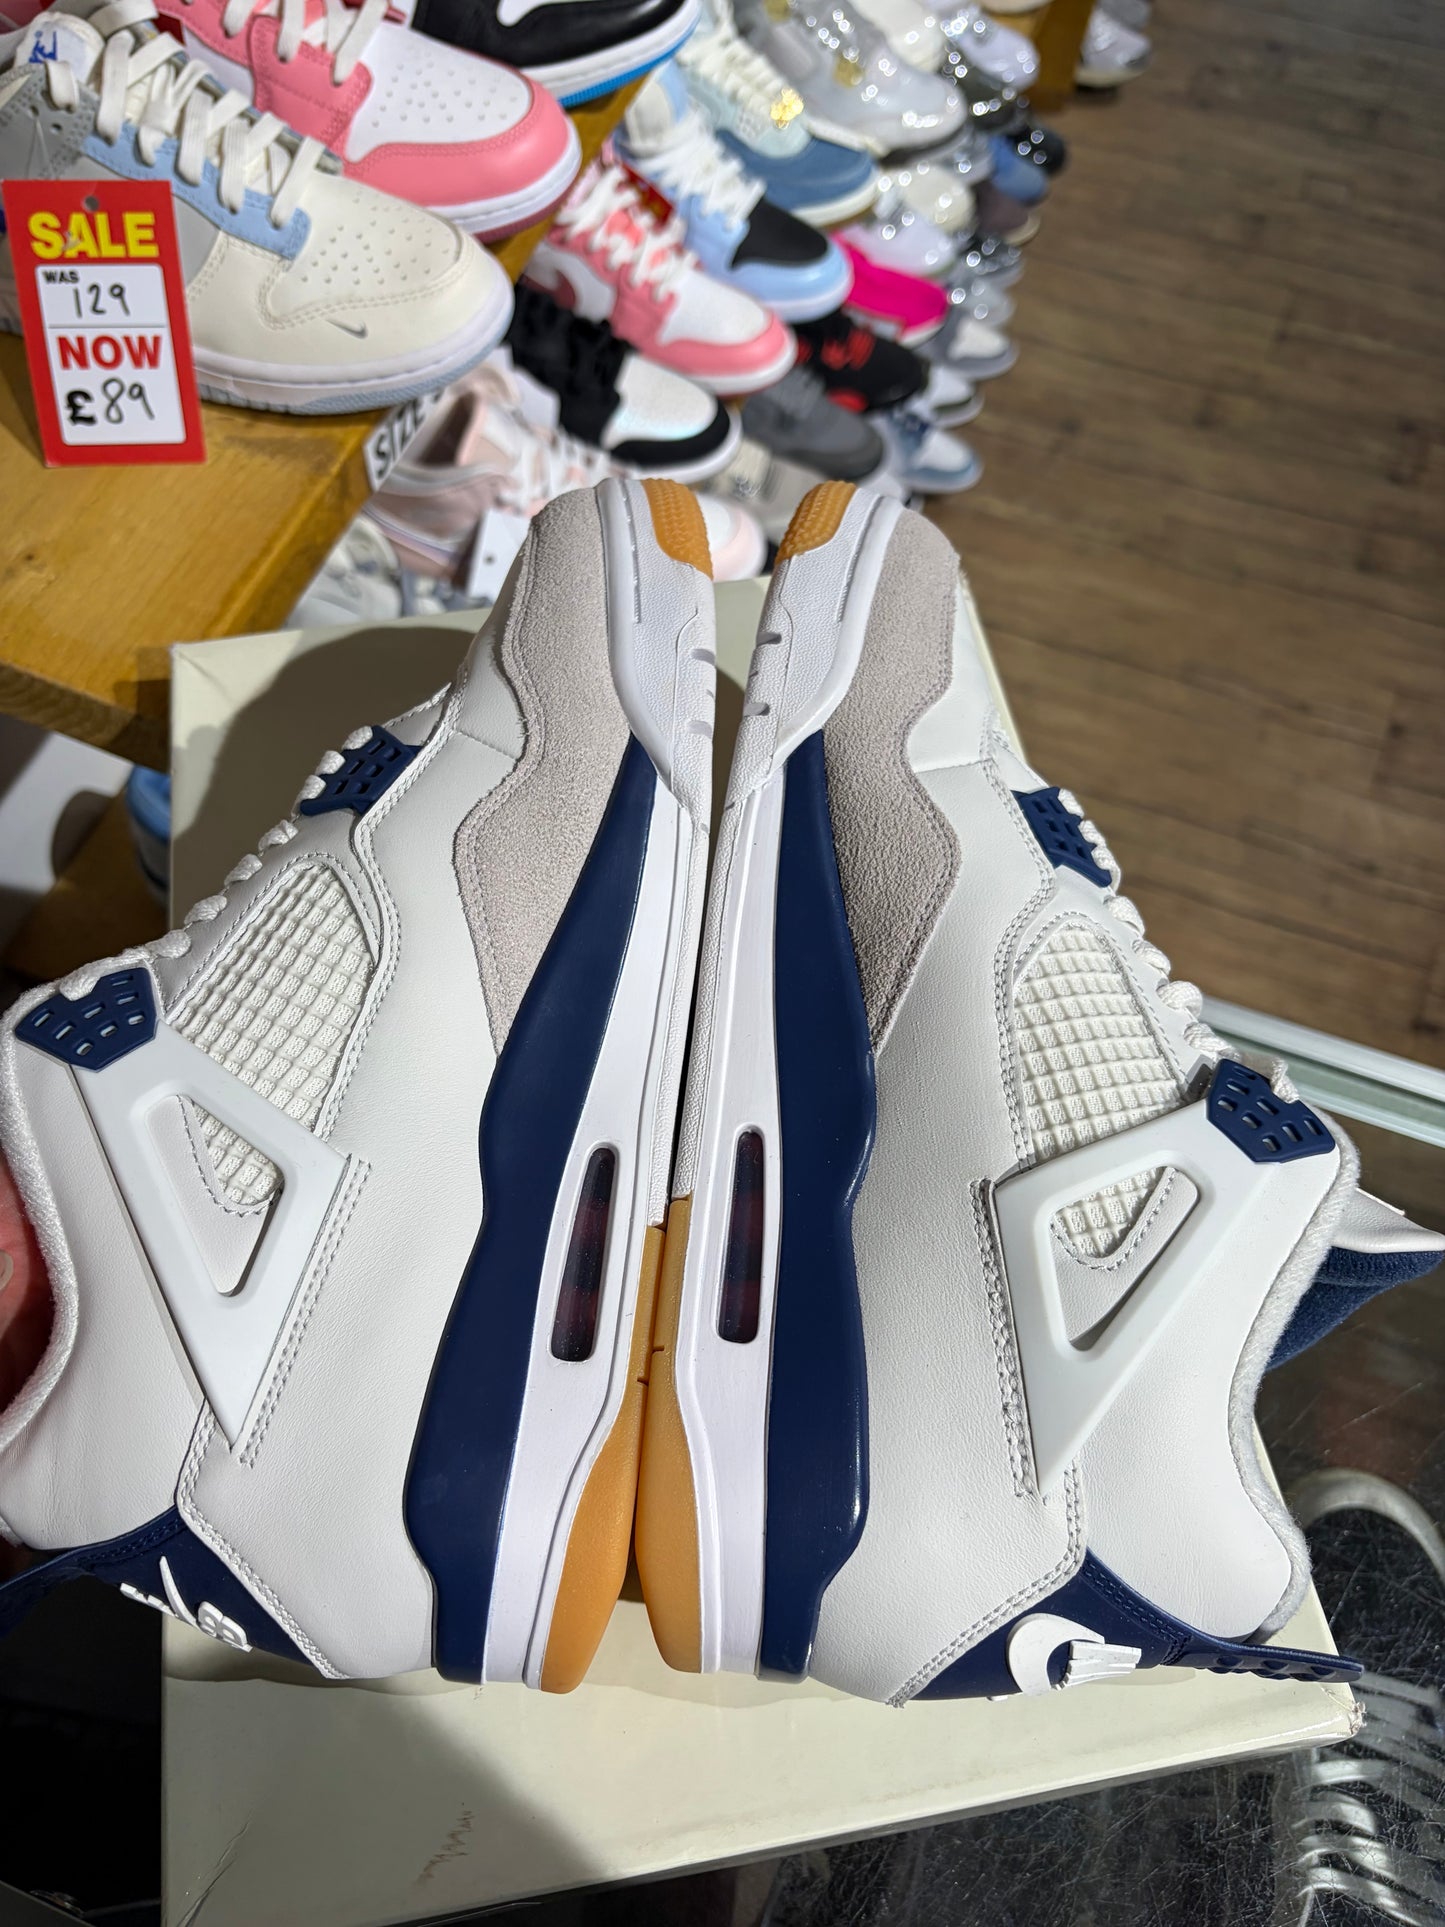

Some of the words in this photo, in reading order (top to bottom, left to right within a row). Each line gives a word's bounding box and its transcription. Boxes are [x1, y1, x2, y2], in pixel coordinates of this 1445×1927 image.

[28, 212, 159, 259] SALE
[43, 271, 80, 284] WAS
[73, 284, 130, 318] 129
[56, 335, 162, 370] NOW
